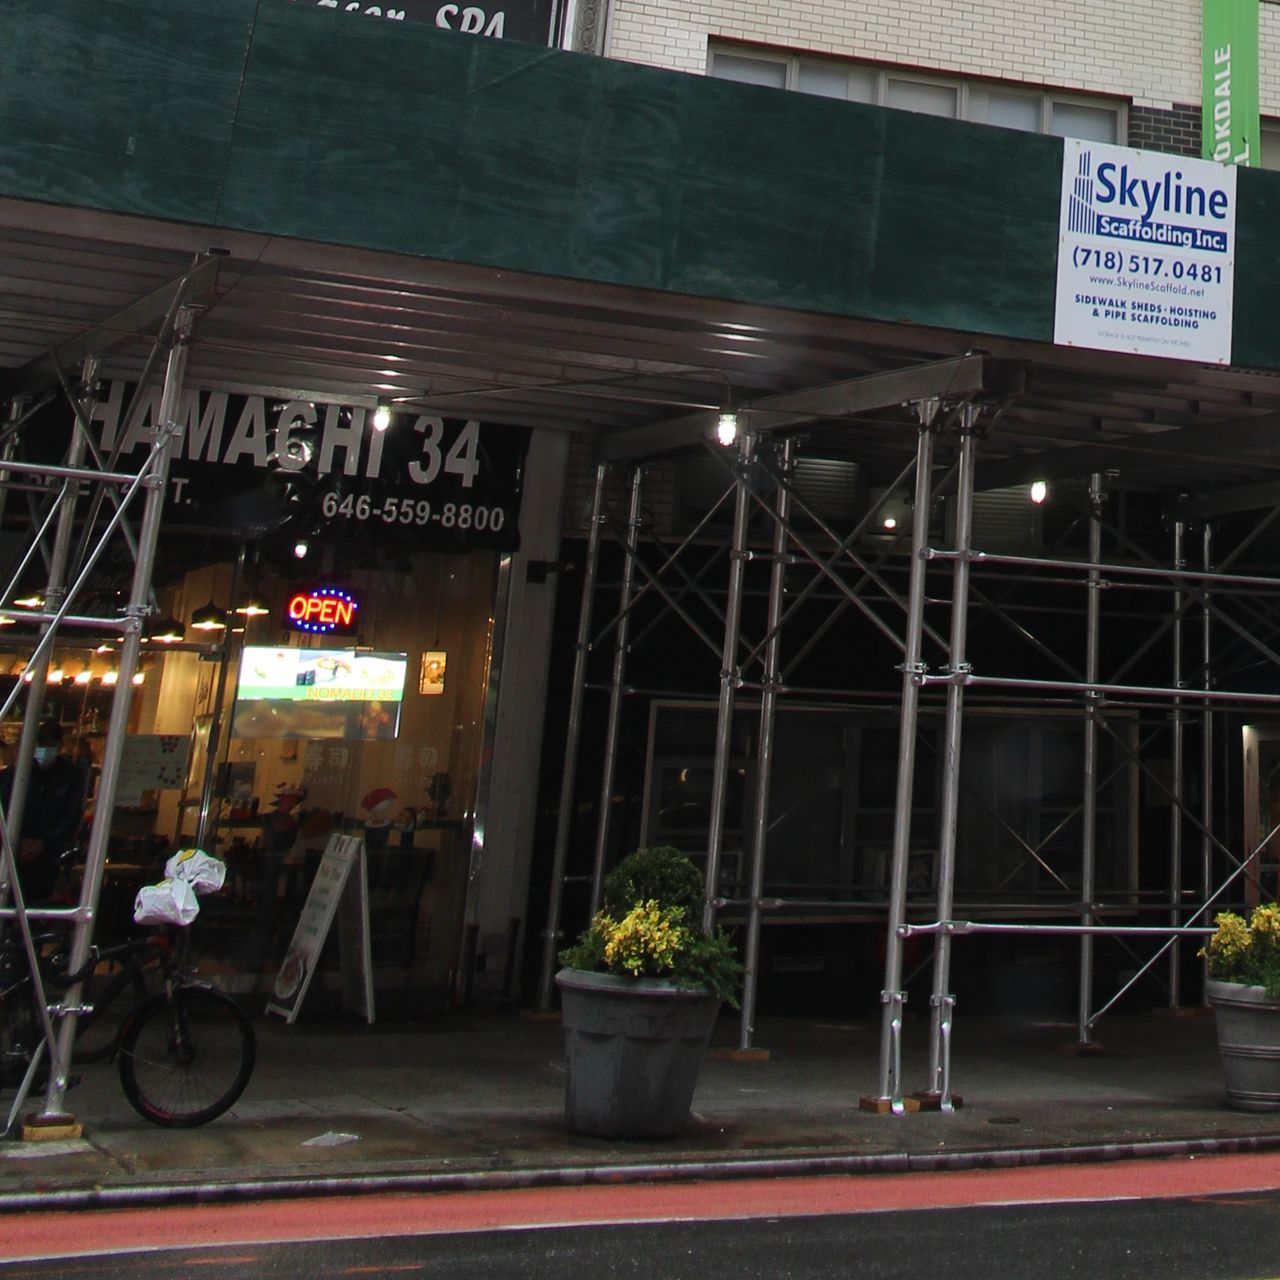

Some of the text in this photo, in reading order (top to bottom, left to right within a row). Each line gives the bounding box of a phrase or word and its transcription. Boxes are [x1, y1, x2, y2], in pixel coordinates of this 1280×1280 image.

[1095, 162, 1228, 223] Skyline
[1101, 217, 1225, 250] Scaffolding Inc.
[1072, 245, 1222, 284] (718) 517.0481
[1089, 274, 1205, 297] www.SkylineScaffold.net
[1074, 293, 1217, 320] SIDEWALK SHEDS HOISTING
[1092, 308, 1199, 330] & PIPE SCAFFOLDING
[91, 379, 481, 488] HAMACHI 34
[321, 491, 505, 533] 646-559-8800
[289, 596, 353, 626] OPEN
